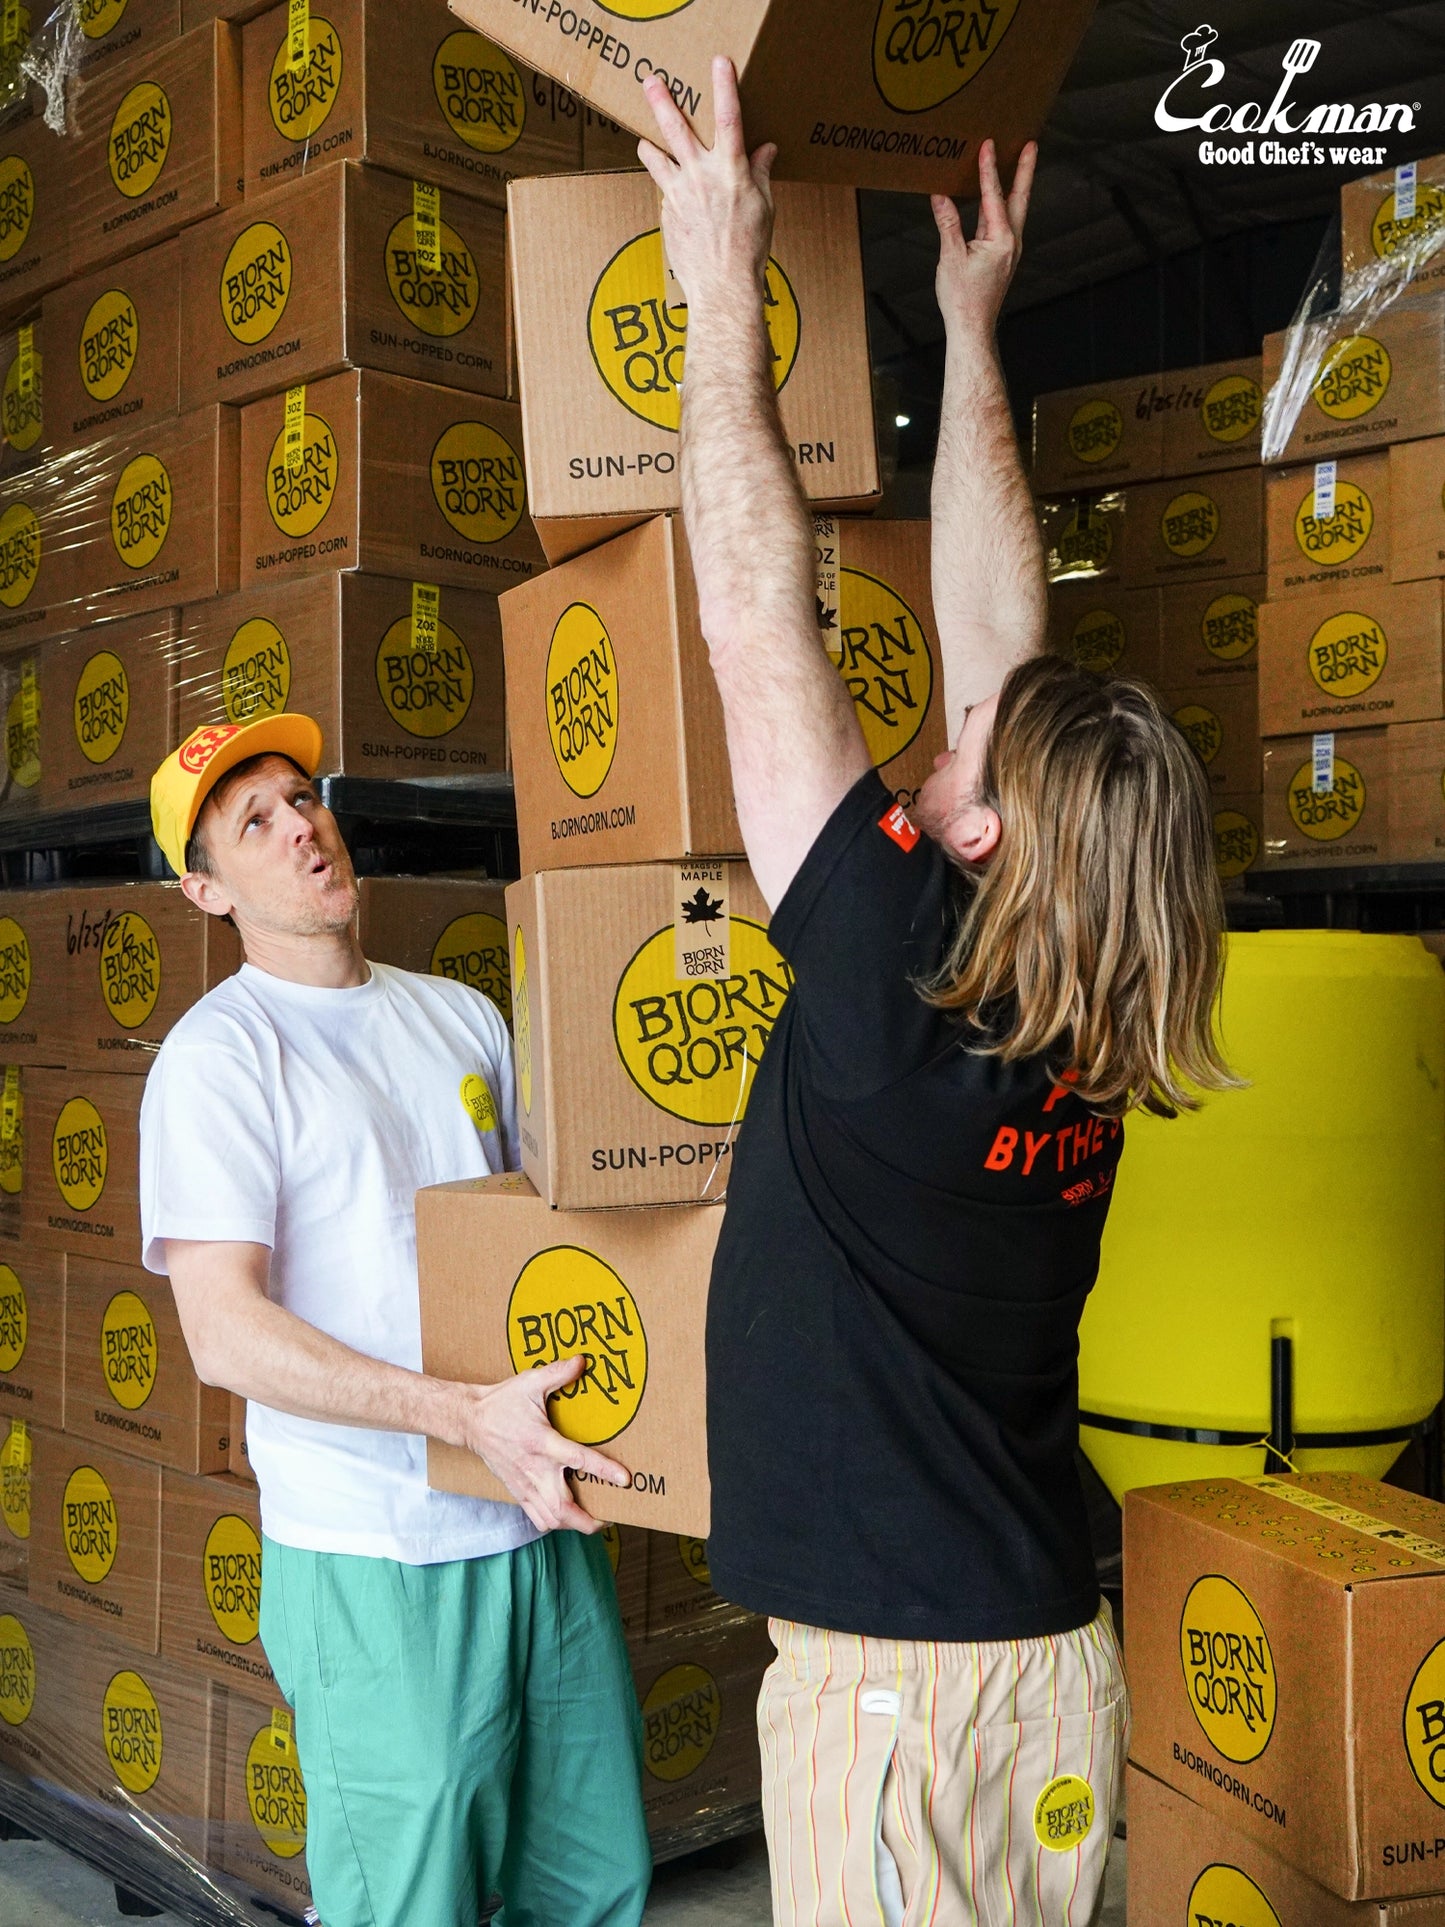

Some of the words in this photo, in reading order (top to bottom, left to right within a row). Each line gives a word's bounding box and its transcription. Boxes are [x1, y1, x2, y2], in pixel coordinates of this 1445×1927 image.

[514, 0, 631, 69] N-POPPED
[885, 9, 999, 68] QORN
[279, 66, 335, 124] QORN
[441, 64, 518, 100] BJORN
[113, 98, 167, 161] BJORN
[447, 95, 518, 134] QORN
[116, 128, 166, 182] QORN
[323, 128, 353, 152] CORN
[810, 122, 968, 161] BJORNQORN.COM
[424, 144, 520, 181] BJORNQORN.C
[0, 171, 30, 212] ORN
[416, 183, 436, 197] 3OZ
[0, 199, 30, 243] ORN
[225, 241, 286, 303] BJORN
[416, 249, 436, 263] 3OZ
[231, 272, 286, 326] QORN
[400, 280, 471, 316] QORN
[84, 306, 134, 363] BJORN
[370, 330, 453, 362] SUN-POPPED
[455, 351, 493, 374] CORN
[87, 338, 133, 384] QORN
[217, 339, 300, 379] BJORNQORN.COM
[1323, 371, 1383, 407] QORN
[438, 457, 518, 492] BJORN
[569, 452, 676, 479] SUN-PO
[116, 473, 167, 528] BJORN
[276, 467, 332, 517] QORN
[445, 486, 518, 520] QORN
[120, 503, 166, 550] QORN
[1306, 519, 1365, 552] QORN
[255, 542, 317, 570] SUN-POPPED
[318, 536, 349, 554] CORN
[420, 544, 533, 574] BJORNQORN.COM
[816, 580, 836, 591] PLE
[416, 619, 436, 631] 3OZ
[227, 641, 285, 692] BJORN
[1315, 628, 1380, 667] BJORN
[383, 647, 467, 688] BJORN
[550, 637, 611, 726] BJORN
[1319, 651, 1379, 684] QORN
[79, 672, 125, 722] BJORN
[231, 674, 284, 718] QORN
[391, 678, 466, 713] QORN
[1301, 700, 1395, 719] BJORNQORN.COM
[81, 704, 124, 744] QORN
[558, 690, 614, 762] QORN
[362, 742, 446, 763] SUN-POPPED
[449, 750, 488, 766] CORN
[551, 806, 637, 840] BJORNQORN.COM
[1298, 795, 1359, 827] QORN
[681, 871, 723, 881] MAPLE
[104, 938, 156, 985] BJORN
[682, 945, 725, 967] BJORN
[685, 959, 725, 976] QORN
[108, 968, 156, 1007] QORN
[629, 961, 795, 1047] BJORN
[57, 1124, 105, 1163] BJORN
[591, 1140, 736, 1172] SUN-POPP
[983, 1125, 1052, 1176] BY
[60, 1154, 104, 1188] QORN
[105, 1323, 153, 1361] BJORN
[517, 1296, 634, 1361] BJORN
[108, 1352, 152, 1387] QORN
[94, 1410, 162, 1442] BJORNQORN.COM
[66, 1500, 113, 1536] BJORN
[69, 1529, 113, 1562] QORN
[209, 1552, 263, 1590] BJORN
[212, 1584, 261, 1621] QORN
[1186, 1628, 1268, 1680] BJORN
[645, 1683, 715, 1742] BJORN
[1193, 1671, 1268, 1733] QORN
[107, 1707, 158, 1741] BJORN
[650, 1711, 713, 1763] QORN
[110, 1735, 157, 1773] QORN
[1173, 1742, 1287, 1829] BJORNQORN.COM
[254, 1793, 307, 1835] QORN
[1046, 1796, 1090, 1827] BJORN
[1382, 1838, 1445, 1867] SUN-P
[292, 1875, 312, 1898] CO
